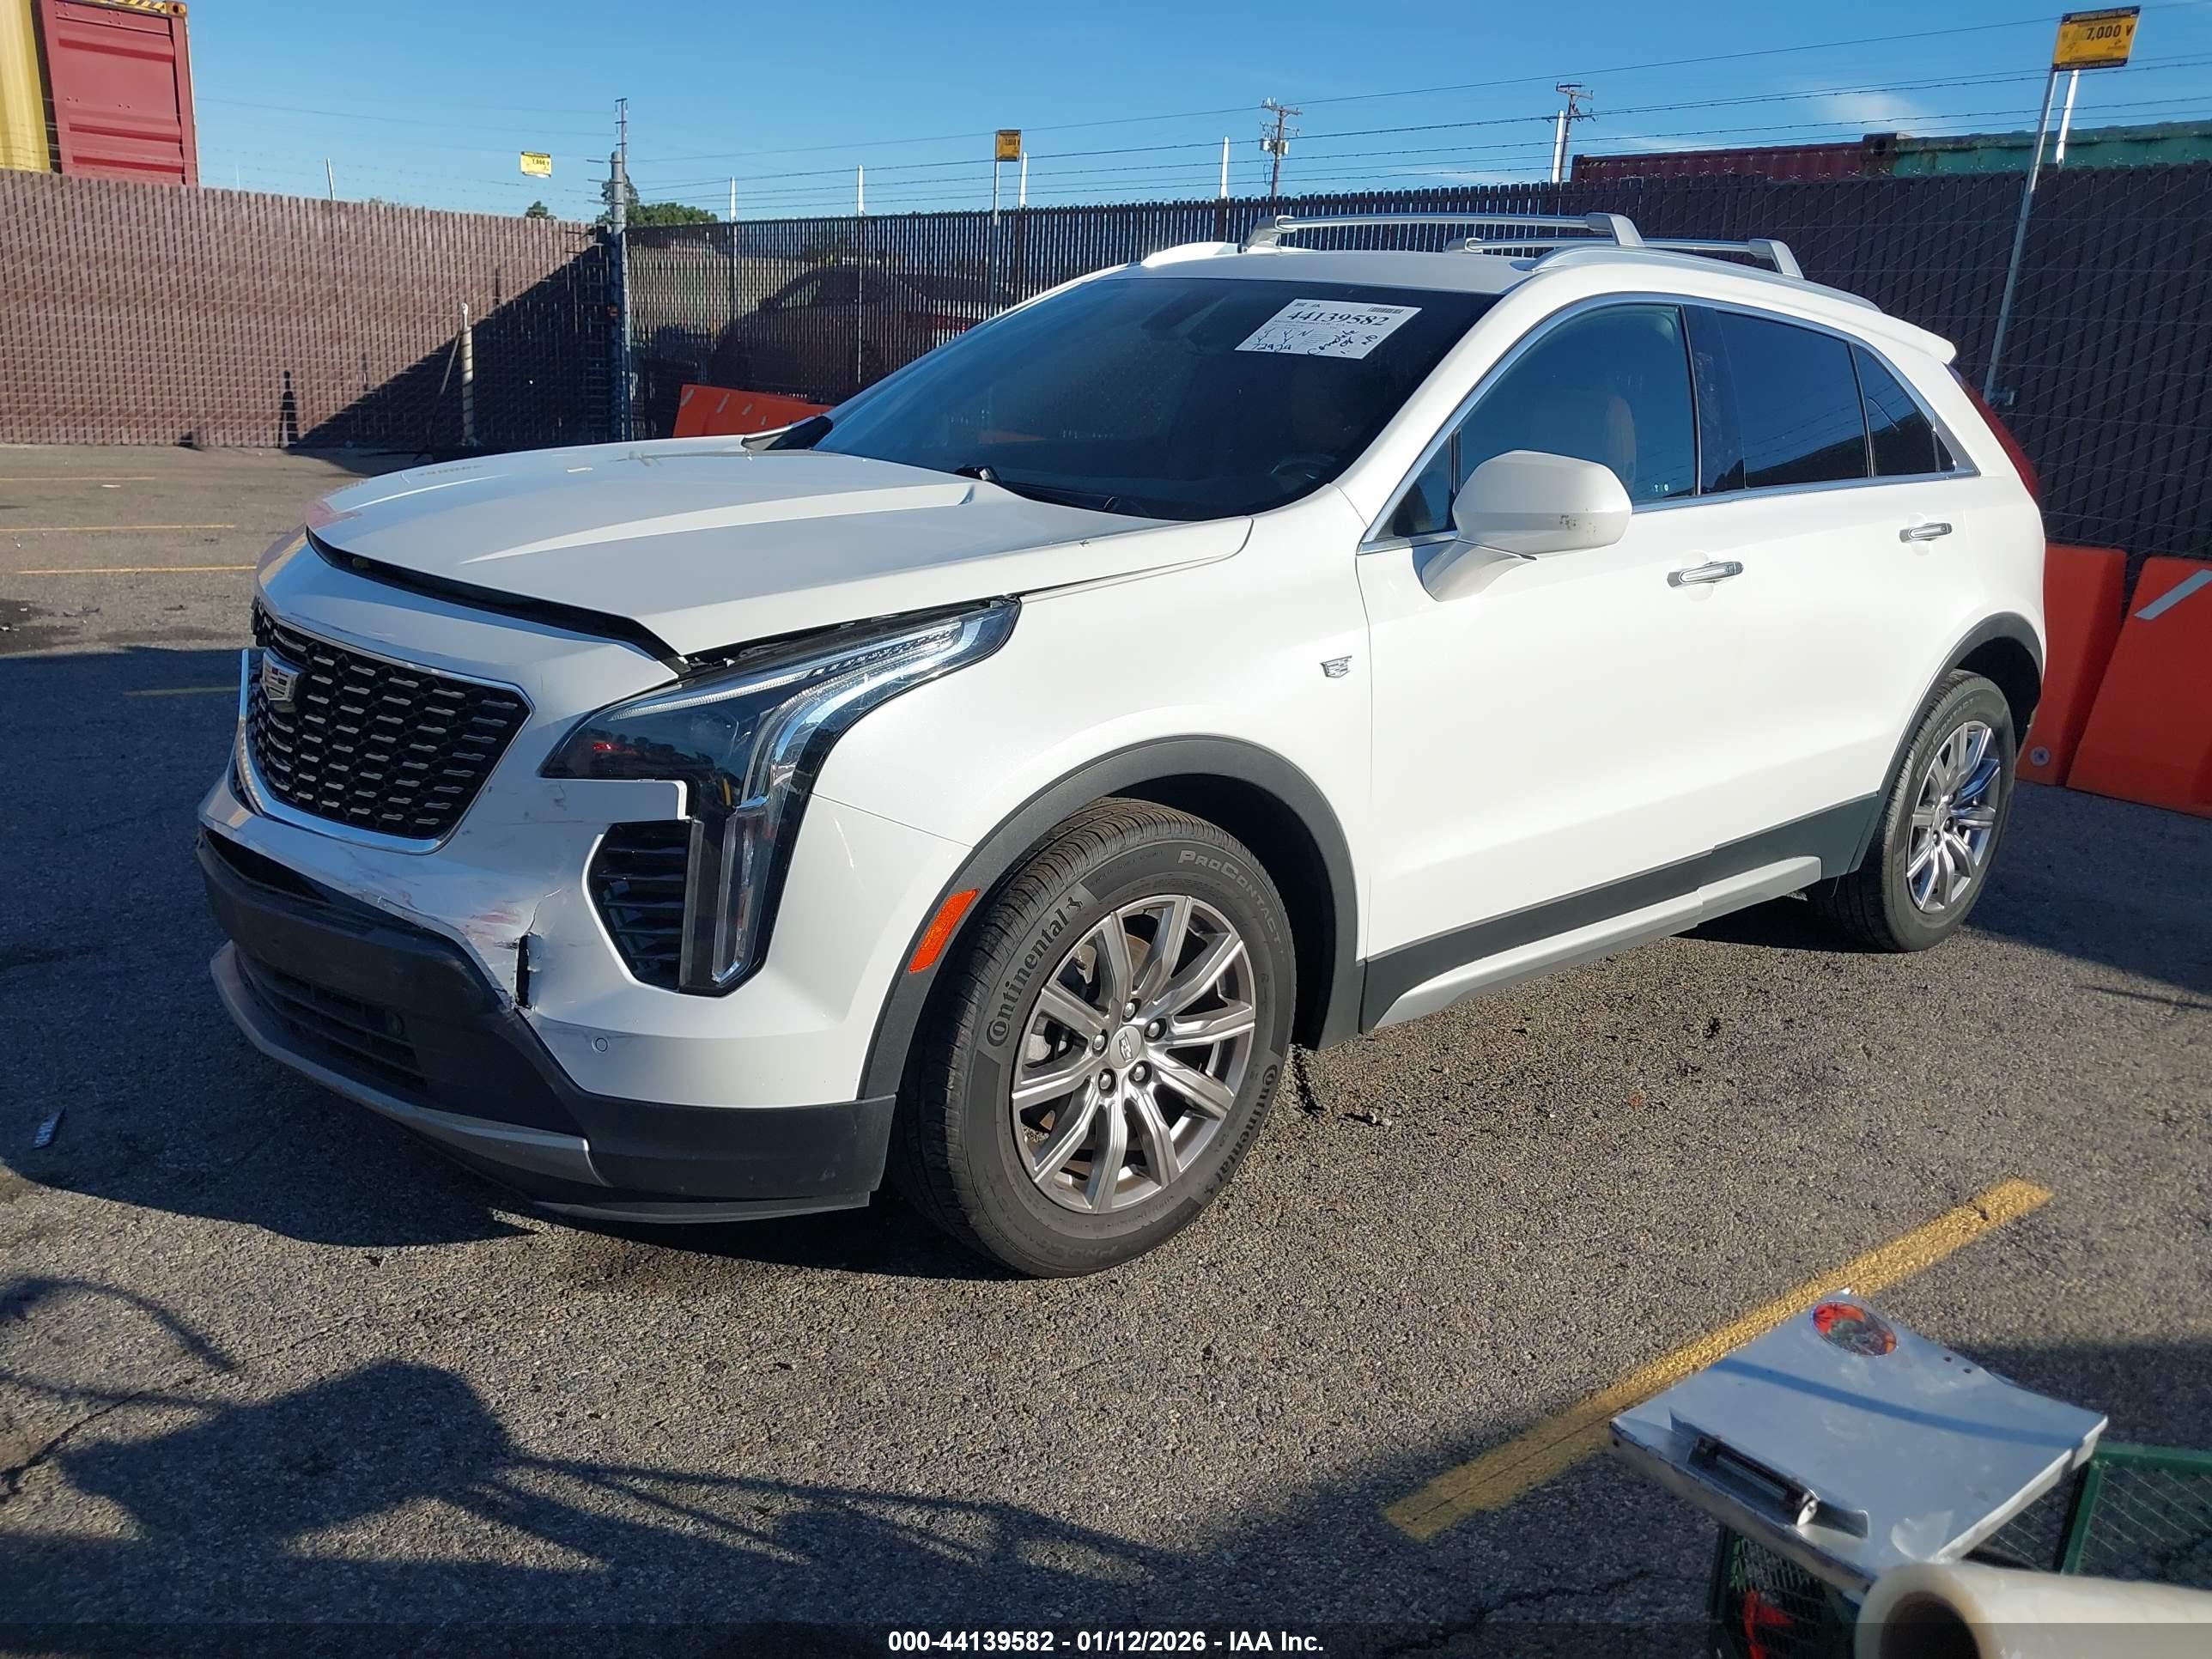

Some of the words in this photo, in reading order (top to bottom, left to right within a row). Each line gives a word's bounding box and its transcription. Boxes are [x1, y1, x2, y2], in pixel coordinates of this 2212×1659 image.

[2087, 25, 2122, 40] 7,000
[2125, 24, 2135, 36] V
[1287, 310, 1390, 326] 44139582
[987, 907, 1073, 1048] Continental
[1217, 1064, 1279, 1183] Continental
